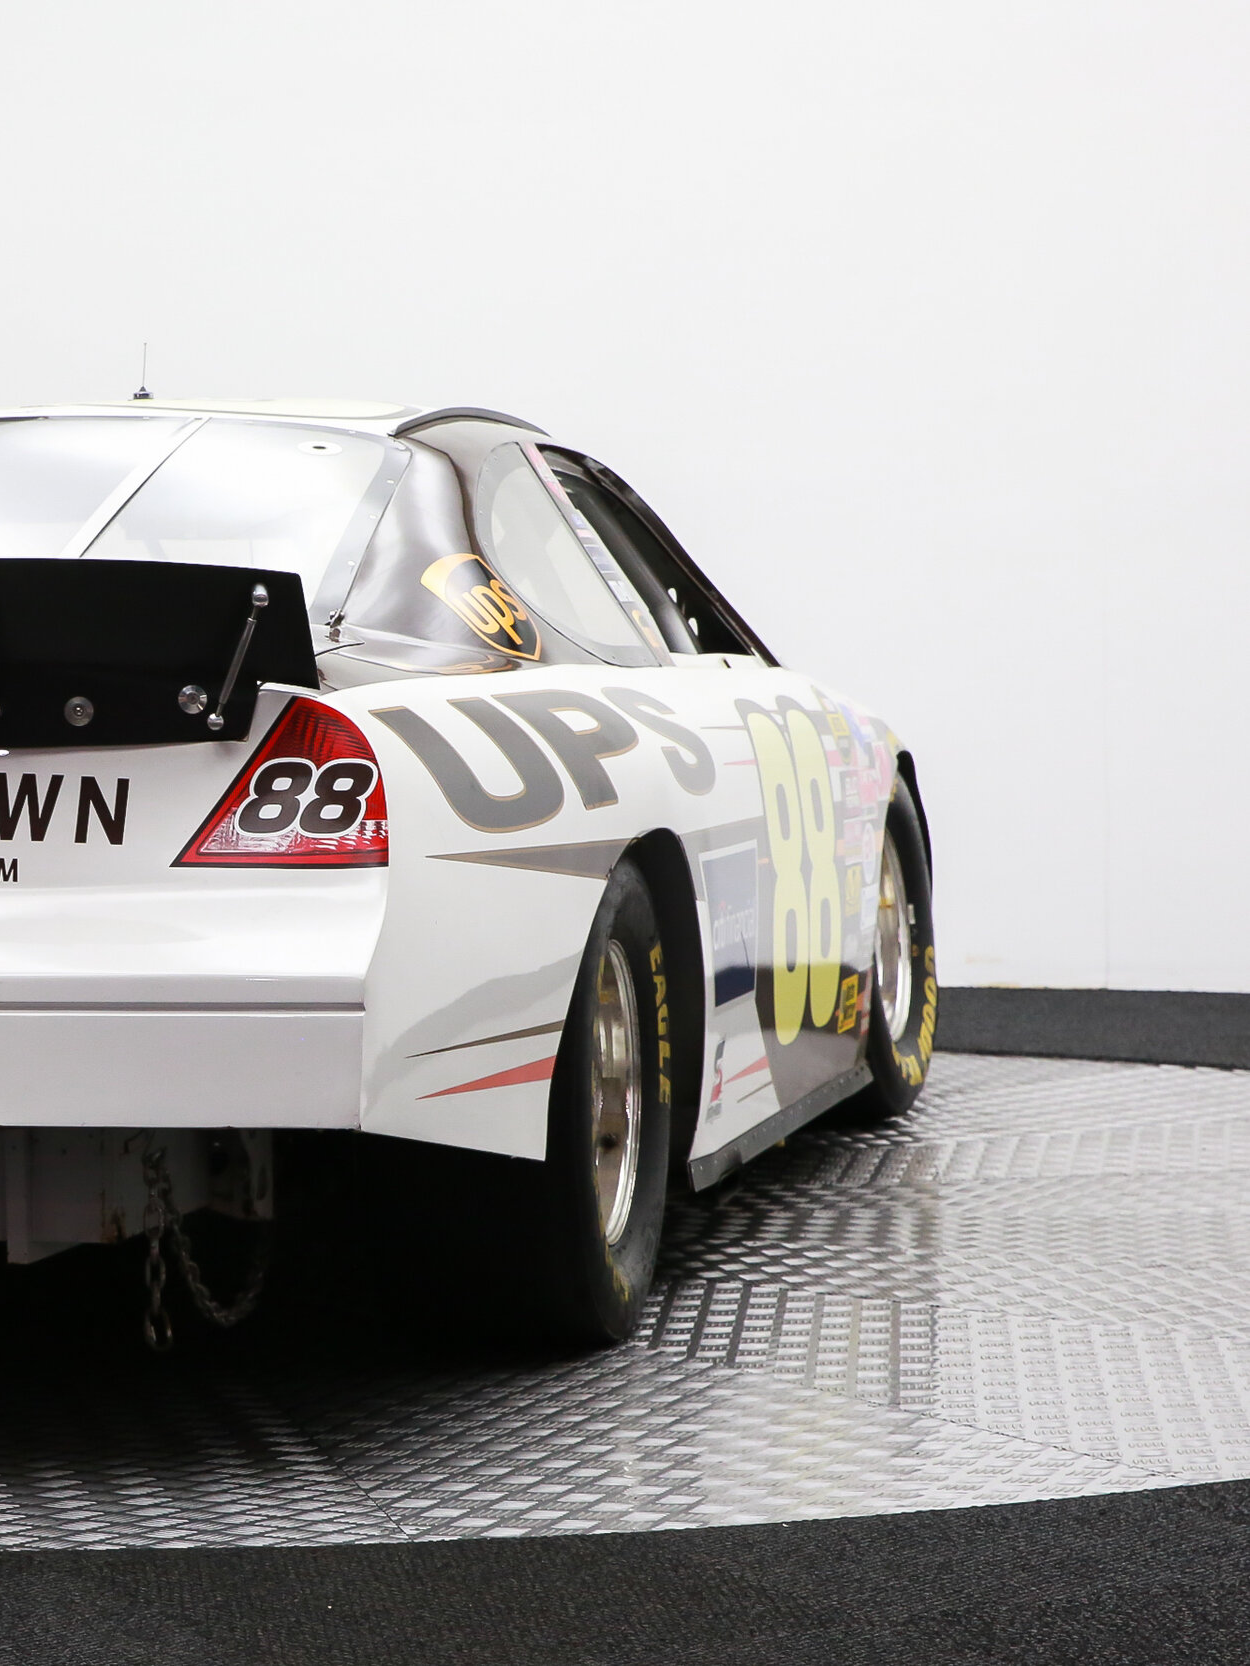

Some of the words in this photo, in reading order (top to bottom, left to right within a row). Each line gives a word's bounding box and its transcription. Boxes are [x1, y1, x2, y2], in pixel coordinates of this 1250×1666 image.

[450, 579, 527, 645] ups
[234, 757, 379, 838] 88
[368, 687, 716, 834] UPS
[735, 695, 842, 1046] 88
[650, 942, 671, 1104] EAGLE
